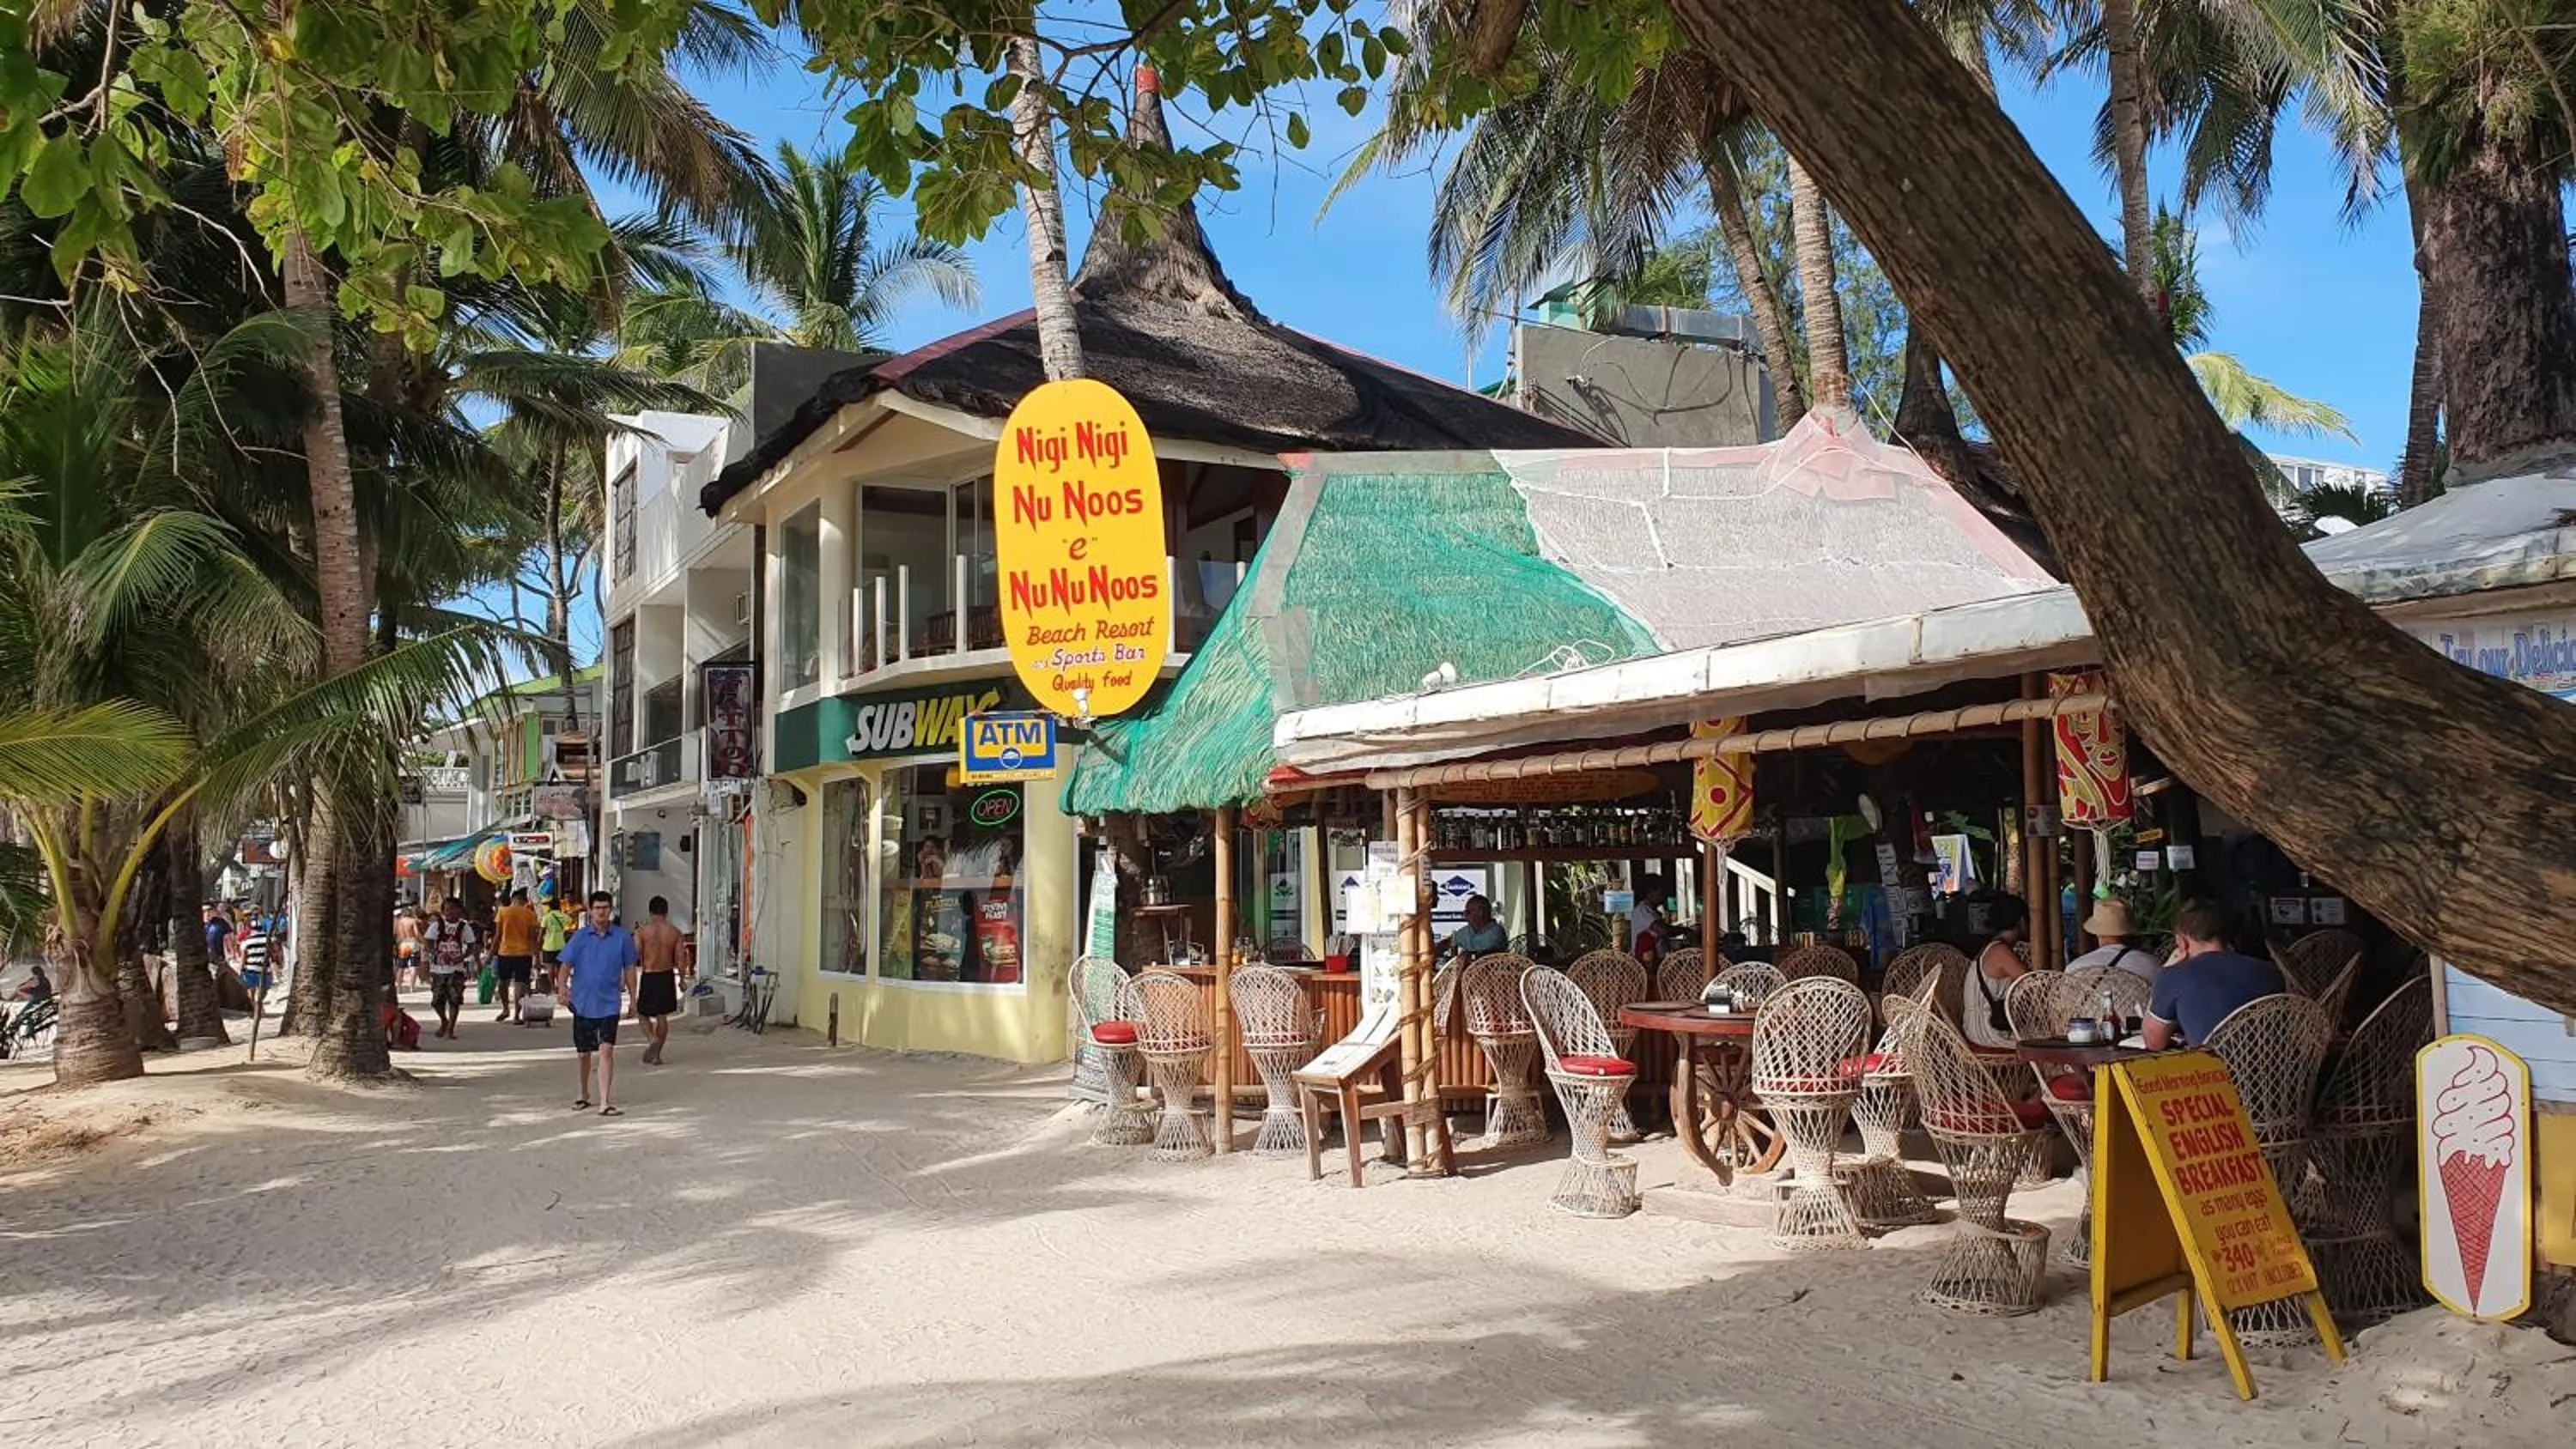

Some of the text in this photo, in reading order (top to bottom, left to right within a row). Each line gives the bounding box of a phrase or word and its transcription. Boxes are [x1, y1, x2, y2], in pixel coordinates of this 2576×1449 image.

[1016, 420, 1128, 473] Nigi Nigi
[1012, 480, 1144, 531] Nu Noos
[1026, 616, 1155, 646] Beach Resort
[1051, 646, 1105, 671] Sports
[1115, 643, 1145, 660] Bar
[1052, 671, 1095, 693] Quality
[979, 722, 1042, 746] ATM
[976, 797, 1013, 816] OPEN
[2160, 1093, 2234, 1127] SPECIAL
[2168, 1121, 2245, 1161] ENGLISH
[2175, 1151, 2265, 1196] BREAKFAST
